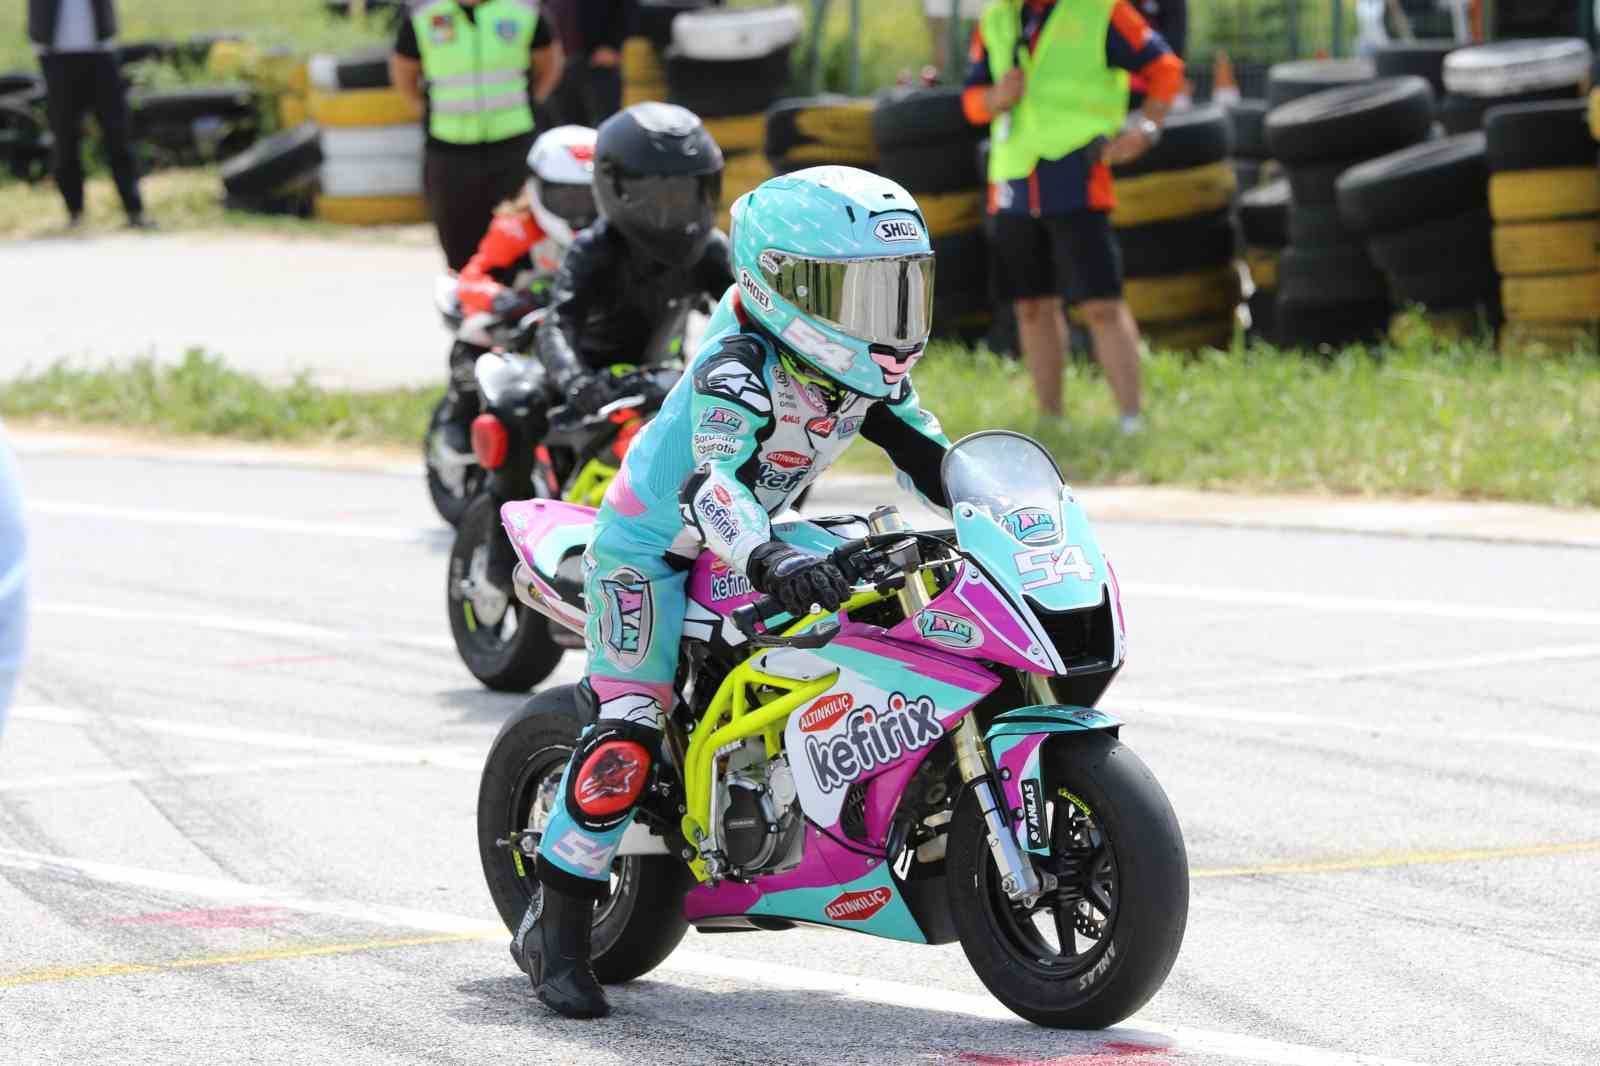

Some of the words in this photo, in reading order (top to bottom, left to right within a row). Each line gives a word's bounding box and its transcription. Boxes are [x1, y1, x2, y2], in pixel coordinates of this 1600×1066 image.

[881, 223, 918, 238] SHOEI
[741, 271, 771, 308] SHOEI
[697, 490, 740, 545] kefirix
[1013, 544, 1096, 592] 54
[807, 694, 944, 792] kefirix
